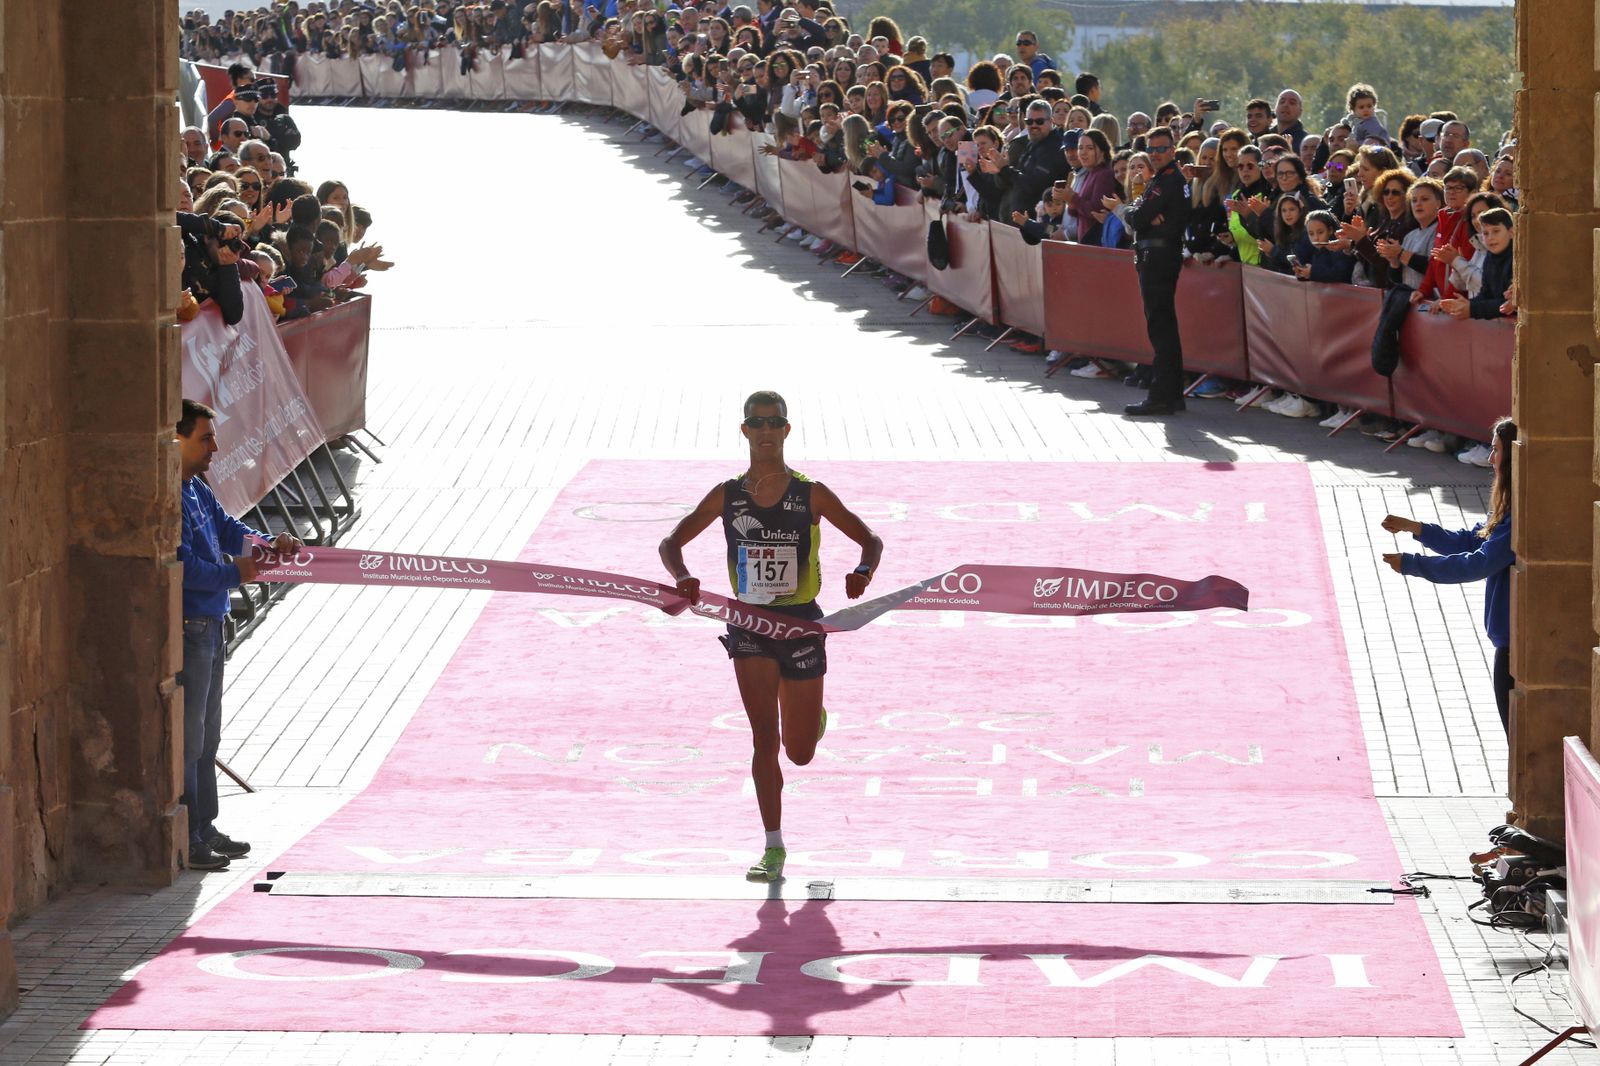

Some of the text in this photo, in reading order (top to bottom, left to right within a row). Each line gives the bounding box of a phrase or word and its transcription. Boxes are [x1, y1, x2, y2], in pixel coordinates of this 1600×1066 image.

[573, 501, 1268, 522] IMDEO
[761, 529, 800, 541] Unicaja
[259, 568, 313, 577] eportes Córdoba
[362, 572, 389, 580] Instituto
[390, 573, 422, 582] Municipal
[433, 575, 462, 583] Deportes
[753, 560, 789, 581] 157
[1066, 577, 1178, 601] IMDECO
[914, 597, 947, 605] Deportes
[948, 597, 980, 605] Córdoba
[1062, 602, 1098, 611] Municipal
[536, 608, 1311, 631] CÓRDBA
[724, 607, 820, 640] IMDEC
[485, 742, 1262, 771] MARAÓN
[198, 947, 1379, 988] IMDECO
